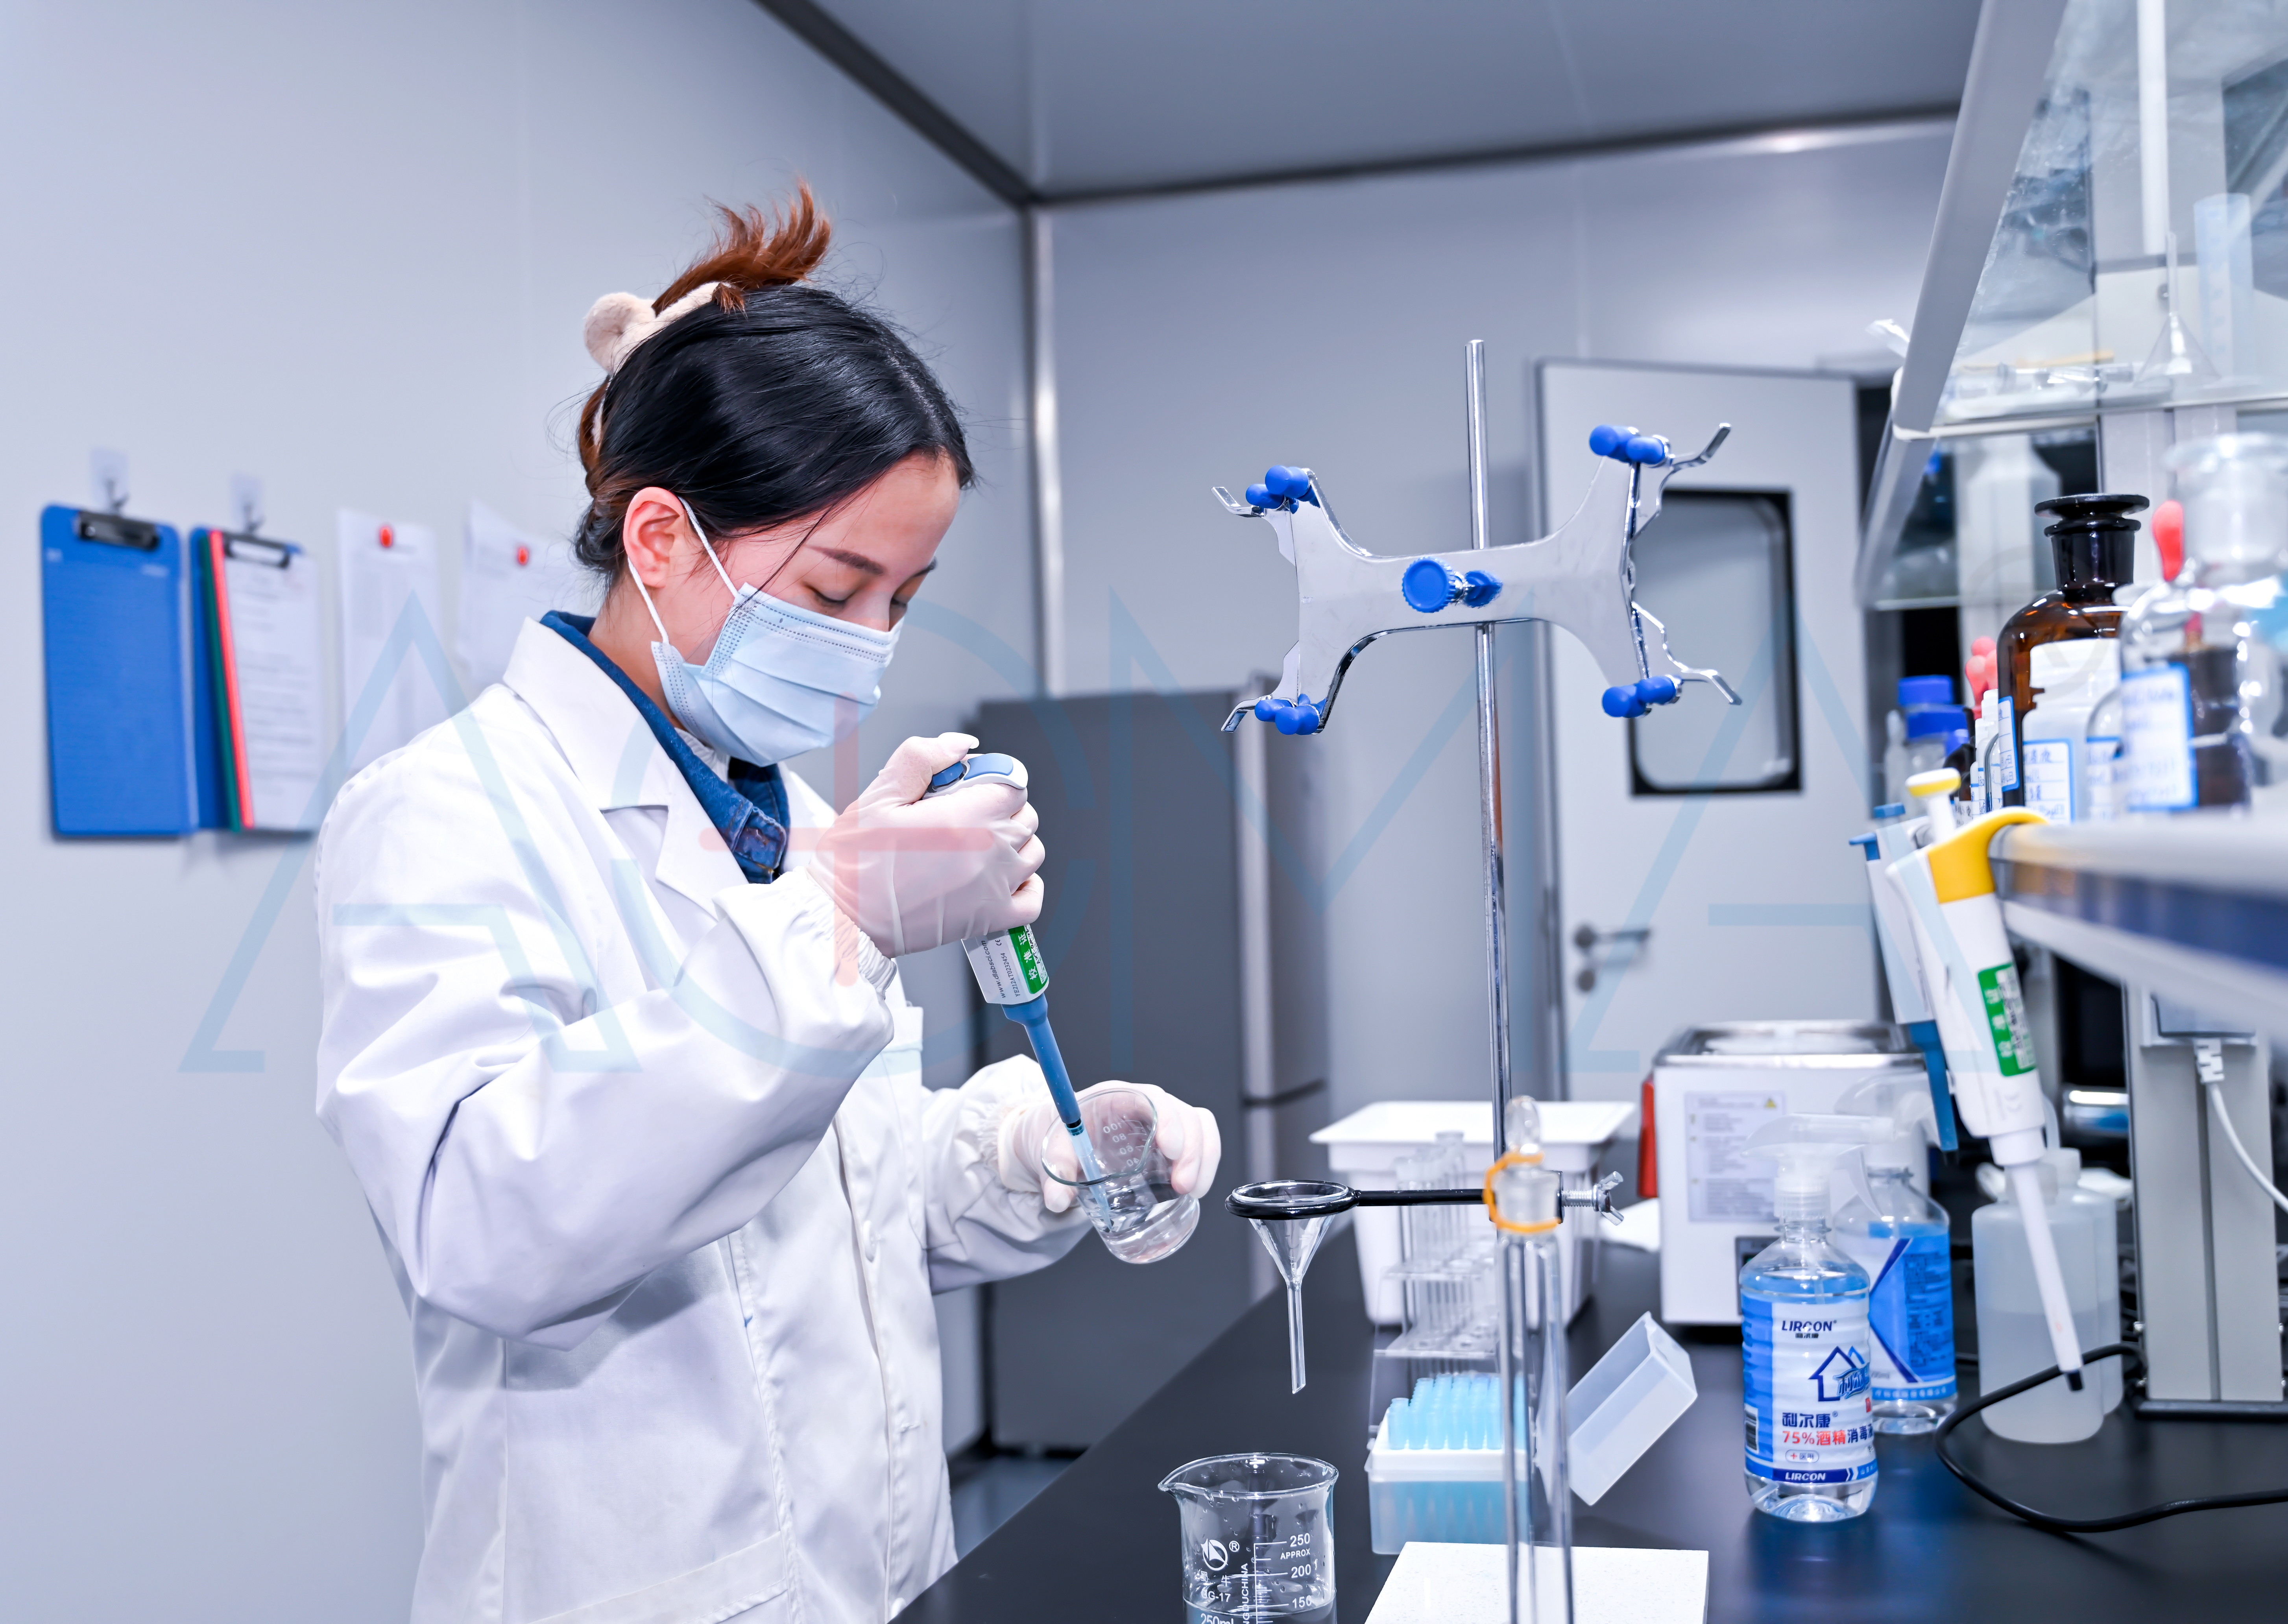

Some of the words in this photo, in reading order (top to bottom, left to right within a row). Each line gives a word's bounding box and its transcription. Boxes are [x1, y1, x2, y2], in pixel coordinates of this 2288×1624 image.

[1018, 931, 1038, 980] 校准证
[981, 941, 1006, 998] www.dlabsci.com
[1001, 953, 1020, 997] YE212AT0232454
[1782, 1320, 1833, 1331] LIRCON
[1782, 1412, 1830, 1428] 利尔康
[1785, 1472, 1826, 1481] LIRCON
[1290, 1533, 1310, 1547] 250
[1280, 1548, 1311, 1560] APPROX
[1291, 1564, 1311, 1578] 200
[1292, 1595, 1312, 1609] 150
